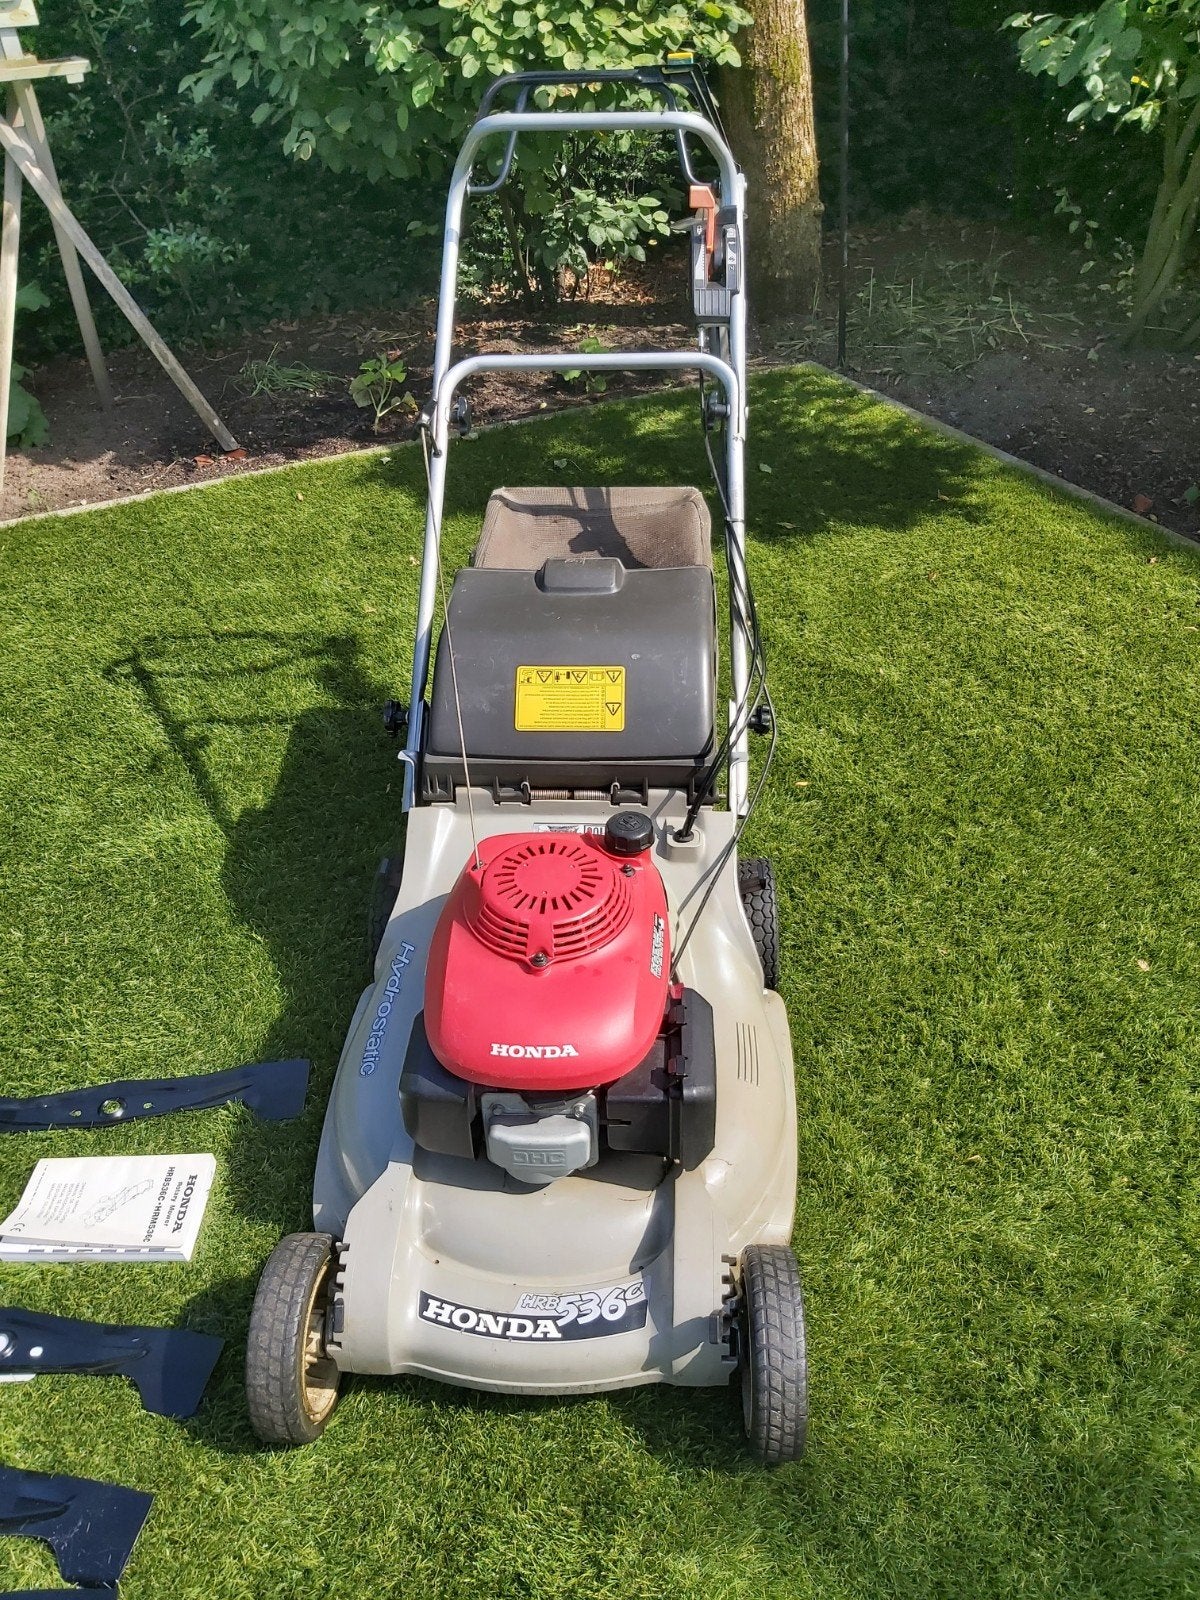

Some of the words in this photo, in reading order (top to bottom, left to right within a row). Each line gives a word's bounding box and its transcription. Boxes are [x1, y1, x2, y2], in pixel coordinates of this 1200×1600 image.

[360, 941, 415, 1077] Hydrostatic
[490, 1043, 579, 1058] HONDA
[170, 1181, 183, 1202] Rotary
[172, 1174, 198, 1233] HONDA
[422, 1299, 562, 1338] HONDA
